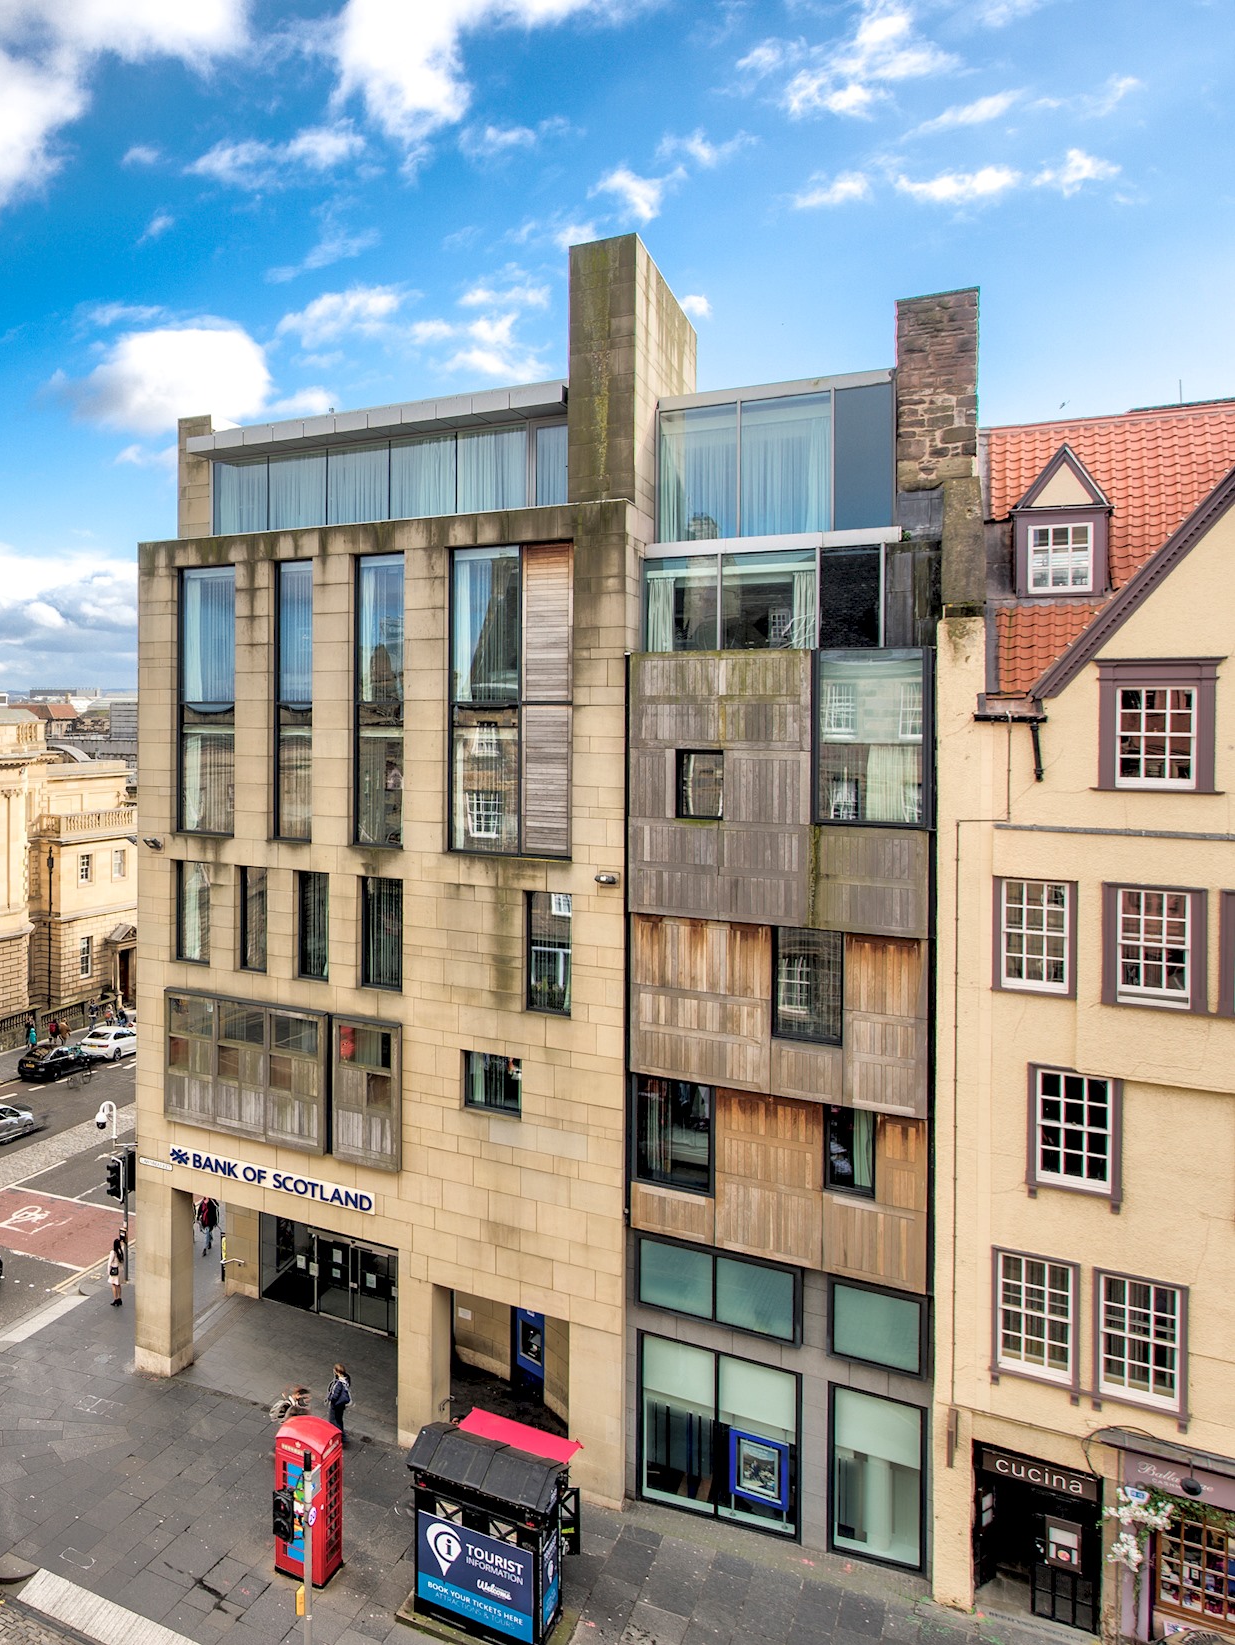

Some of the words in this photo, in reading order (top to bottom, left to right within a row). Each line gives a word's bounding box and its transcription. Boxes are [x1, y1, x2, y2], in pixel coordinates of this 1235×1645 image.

[192, 1153, 238, 1179] BANK
[243, 1166, 267, 1185] OF
[272, 1173, 373, 1212] SCOTLAND
[995, 1459, 1083, 1495] cucina
[466, 1543, 524, 1576] TOURIST
[466, 1556, 524, 1586] INFORMATION
[427, 1581, 449, 1596] BOOK
[450, 1591, 471, 1604] YOUR
[472, 1599, 502, 1617] TICKETS
[504, 1612, 524, 1626] HERE
[476, 1578, 512, 1601] Welcome
[435, 1593, 482, 1616] ATTRACTIONS
[483, 1611, 490, 1620] &
[491, 1615, 516, 1630] TOURS
